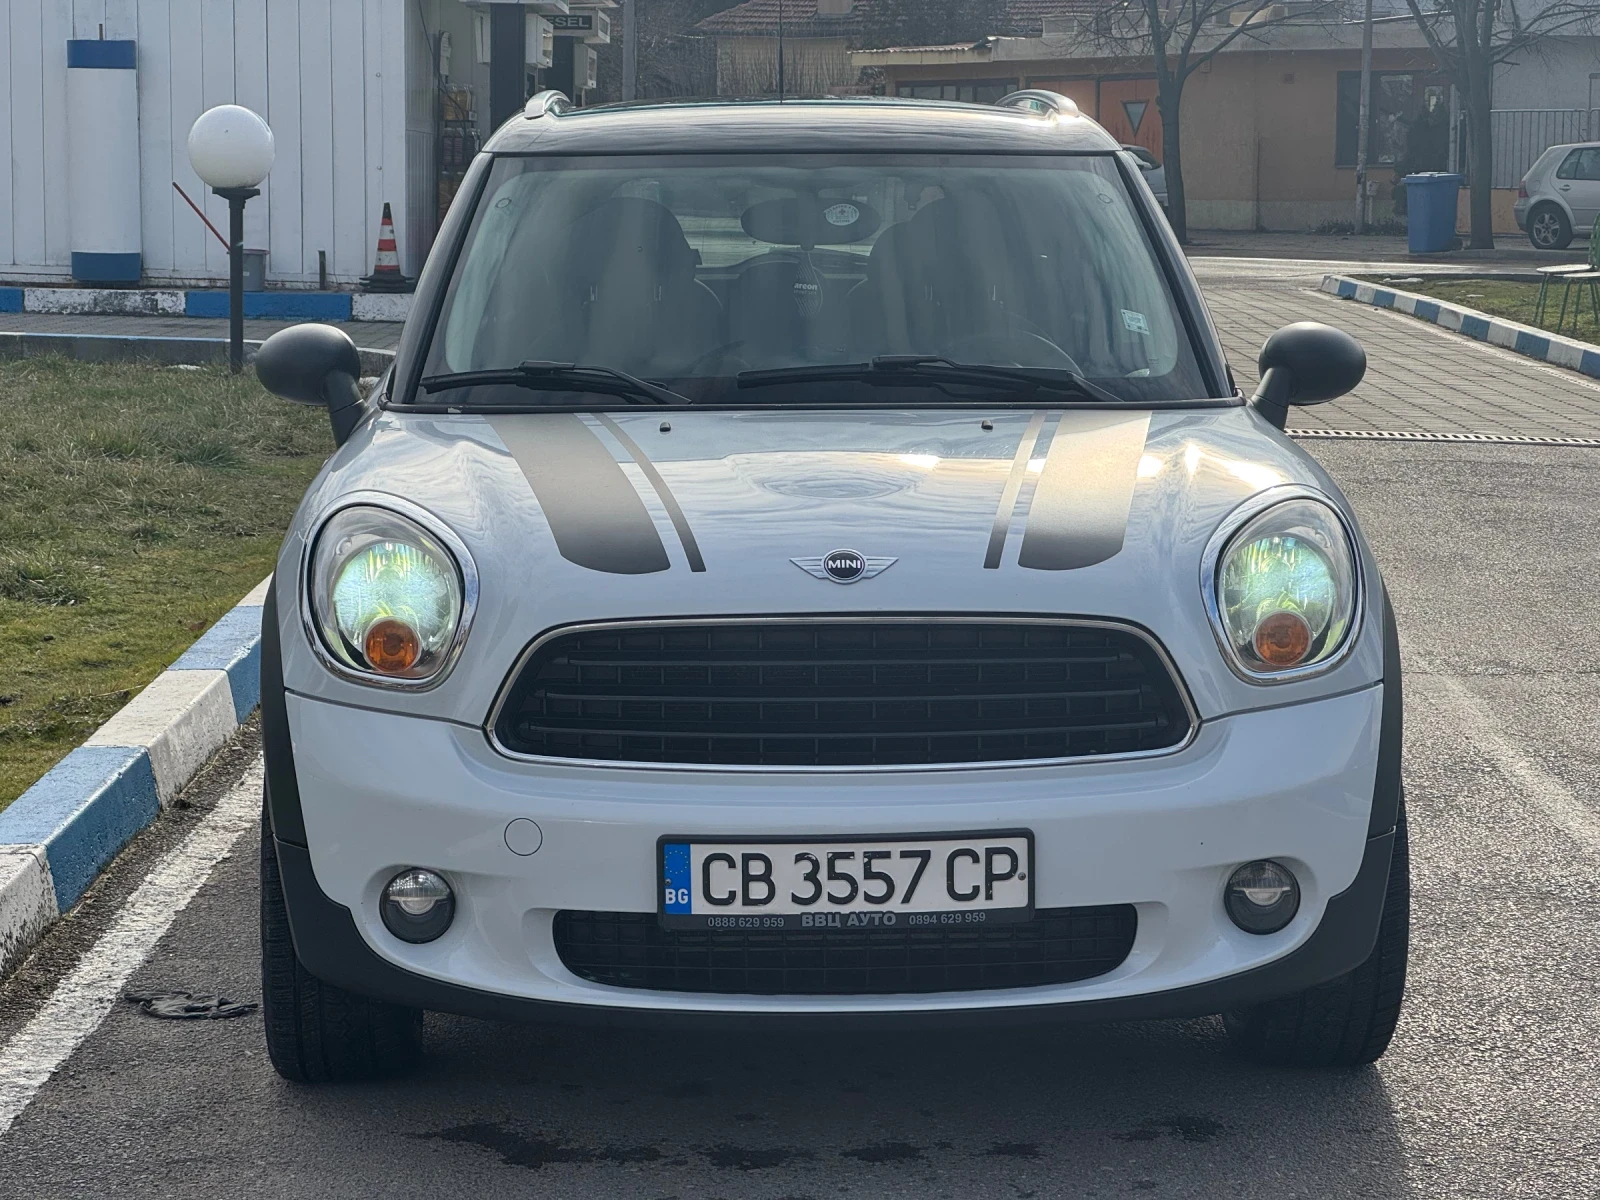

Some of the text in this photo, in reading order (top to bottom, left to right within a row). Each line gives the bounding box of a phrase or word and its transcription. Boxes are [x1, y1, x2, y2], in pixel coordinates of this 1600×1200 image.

[828, 560, 861, 568] MINI
[702, 846, 1019, 906] CB 3557 CP
[665, 888, 688, 904] BG
[707, 912, 986, 928] 0888 629 959 ВВЦ АУТО 0894 629 959
